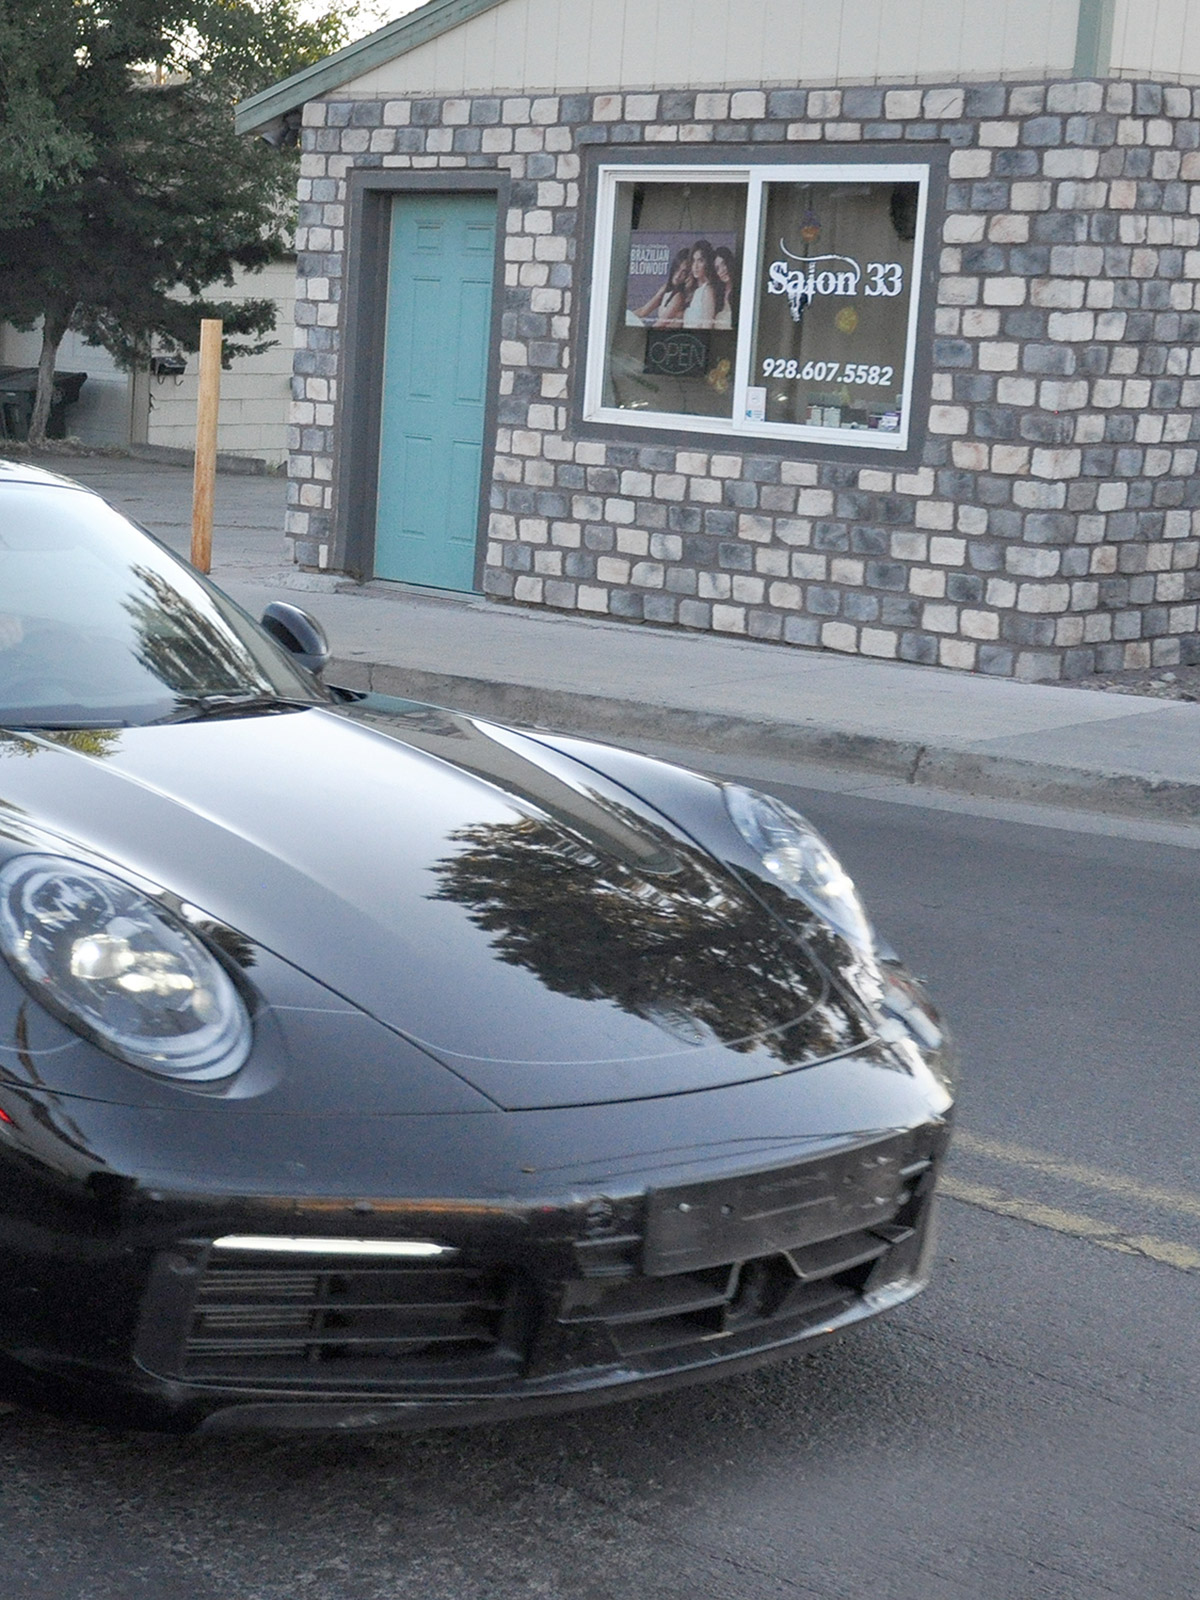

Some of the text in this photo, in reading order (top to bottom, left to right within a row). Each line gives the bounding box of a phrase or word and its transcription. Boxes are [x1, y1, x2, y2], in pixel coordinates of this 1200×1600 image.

[629, 261, 669, 275] BLOWOUT
[630, 248, 670, 261] BRAZILIAN
[767, 260, 903, 297] Salon 33
[649, 341, 707, 368] OPEN
[762, 358, 893, 386] 928.607.5582
